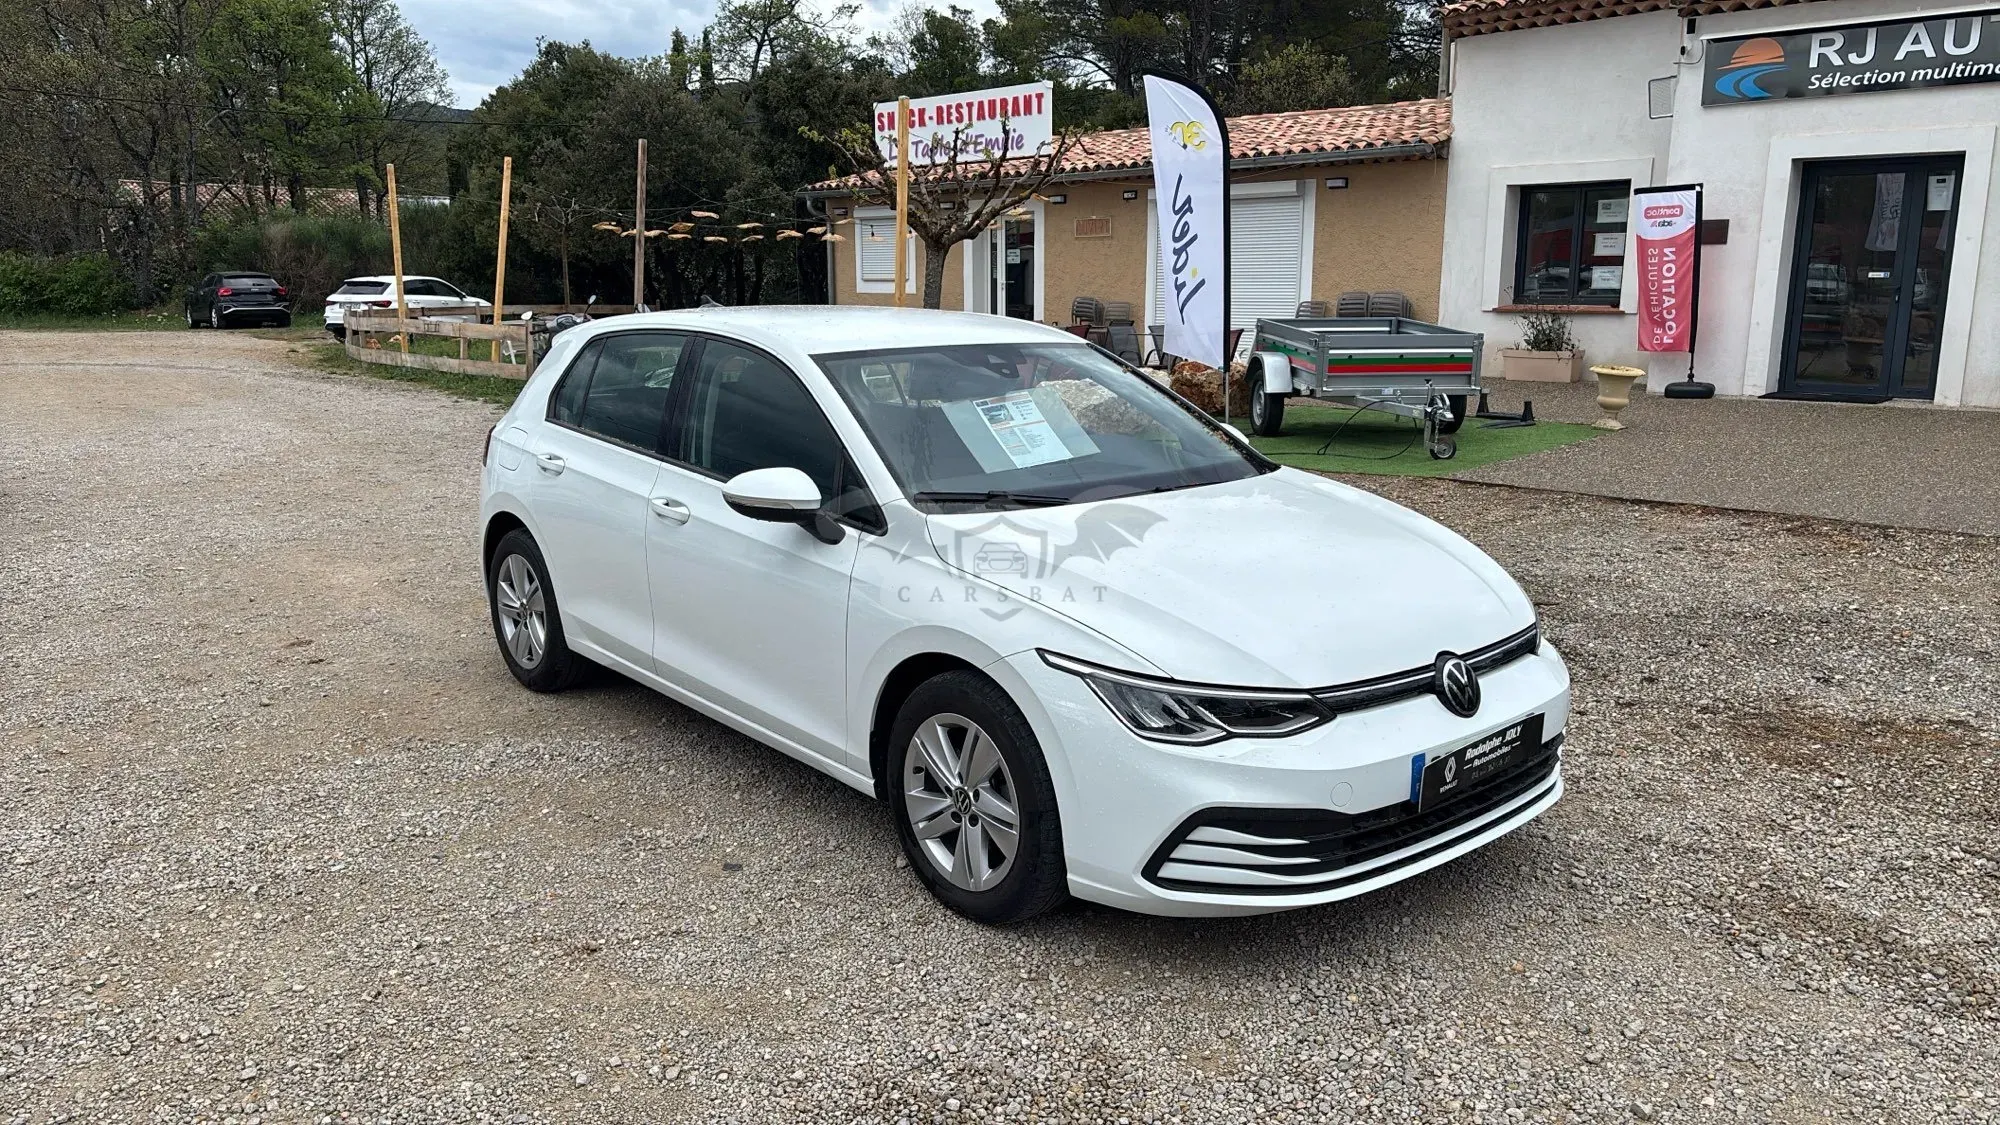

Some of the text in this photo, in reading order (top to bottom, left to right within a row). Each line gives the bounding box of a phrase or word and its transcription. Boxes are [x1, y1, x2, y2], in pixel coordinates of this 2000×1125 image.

[1808, 16, 2000, 68] RJ AU
[1808, 67, 1905, 89] Sélection
[877, 92, 1044, 132] SNCK-RESTAURANT
[1465, 724, 1523, 760] Rodolphe JOLY
[1473, 744, 1511, 767] Automobiles
